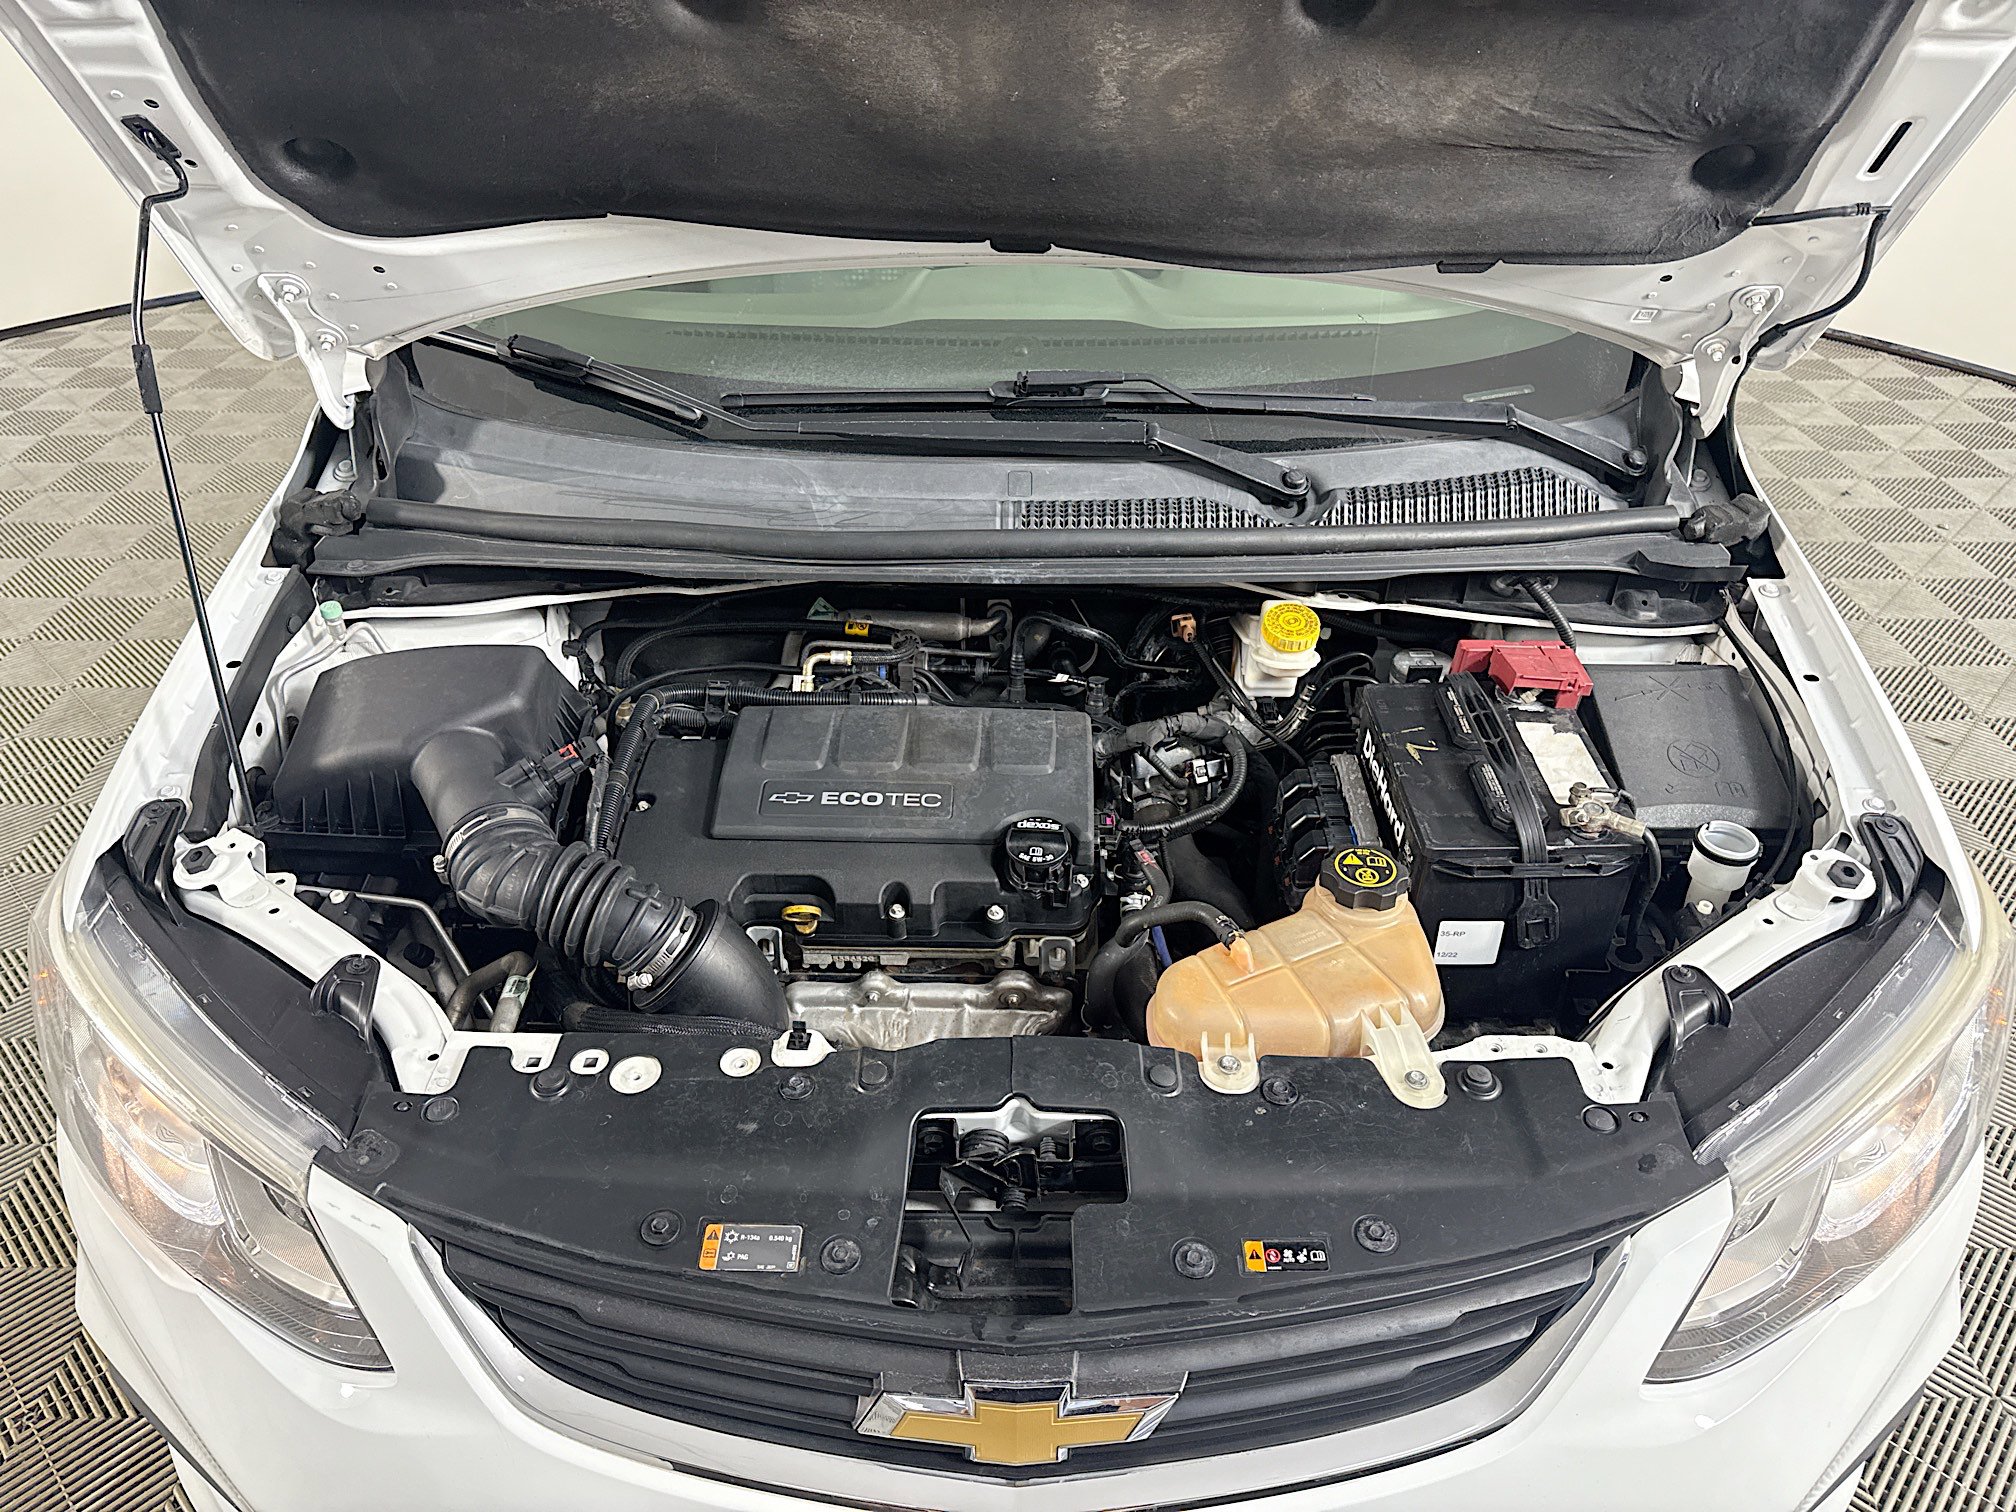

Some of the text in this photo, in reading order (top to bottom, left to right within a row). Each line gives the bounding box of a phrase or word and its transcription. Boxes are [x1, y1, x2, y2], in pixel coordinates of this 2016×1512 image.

[1363, 728, 1406, 848] DieHard
[820, 791, 943, 808] ECOTEC
[1017, 820, 1061, 830] dexos
[740, 1233, 761, 1241] R-134a
[785, 1234, 793, 1243] kg
[736, 1253, 749, 1261] PAG
